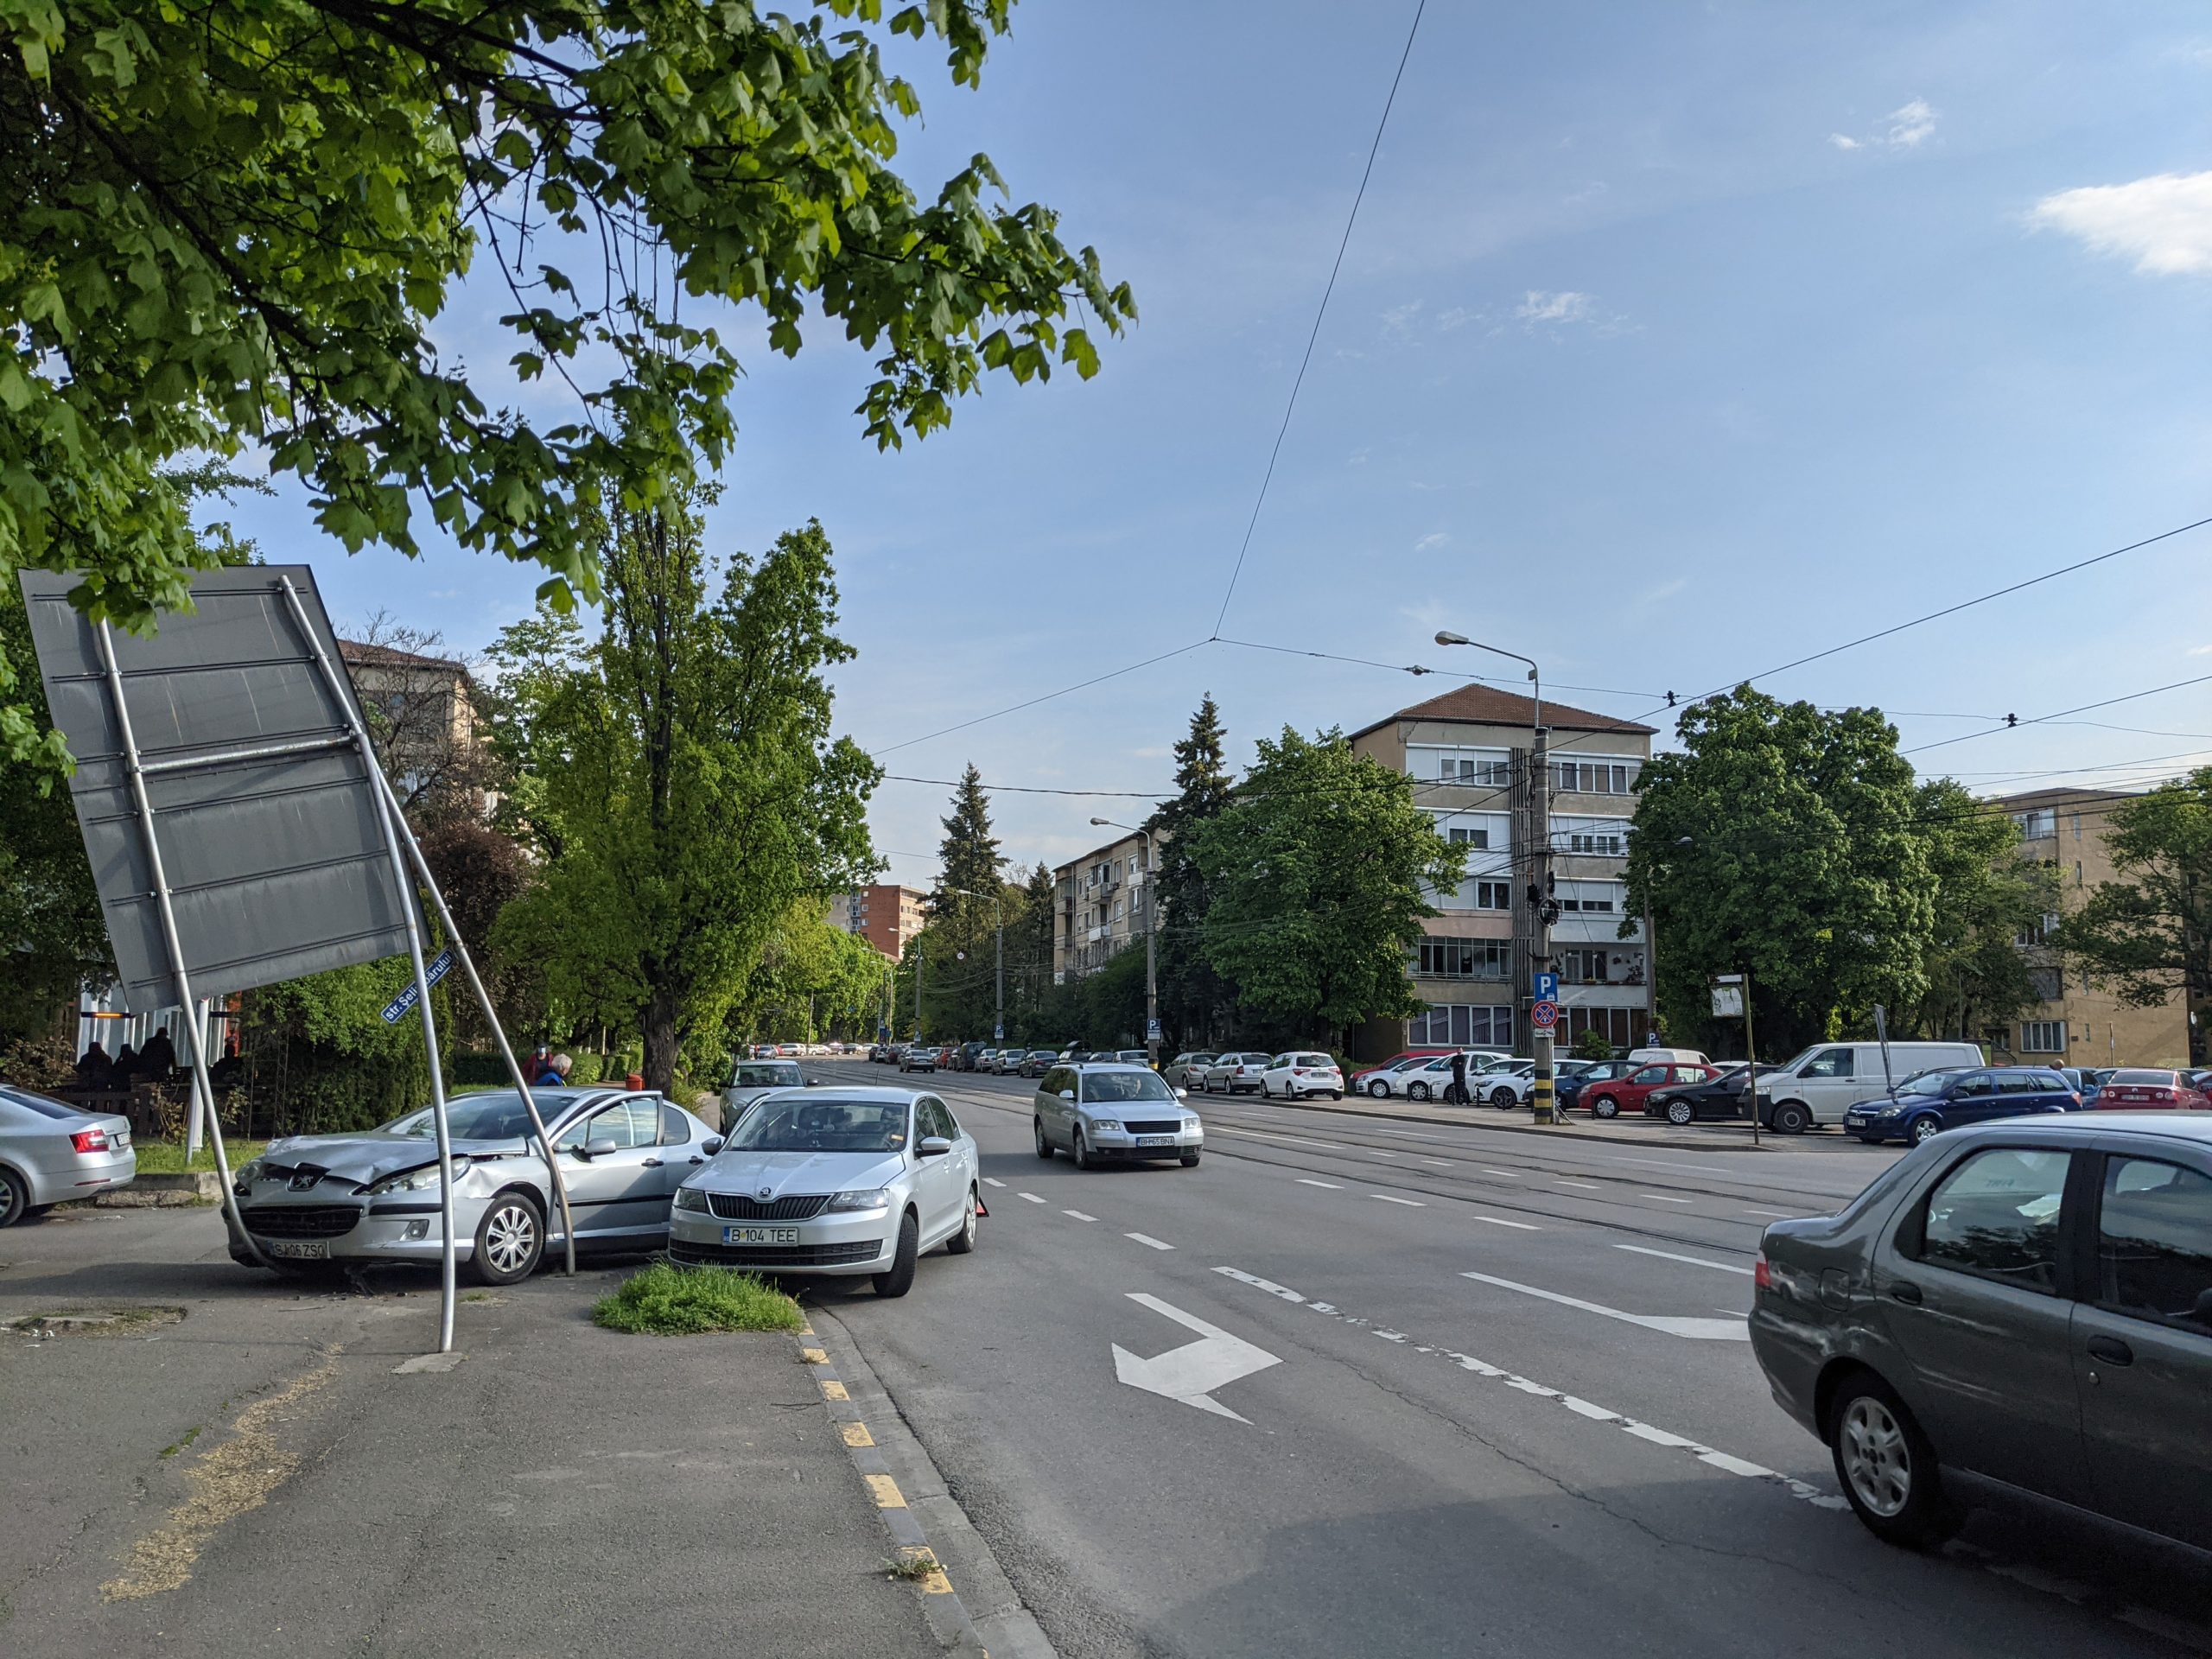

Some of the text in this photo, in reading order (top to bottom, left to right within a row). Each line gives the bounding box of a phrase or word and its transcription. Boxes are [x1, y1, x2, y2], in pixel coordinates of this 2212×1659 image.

[385, 953, 453, 1020] str. Șeliărului
[1540, 976, 1552, 995] P
[1149, 1020, 1157, 1030] P
[1649, 1033, 1656, 1044] P
[731, 1229, 796, 1242] B 104 TEE
